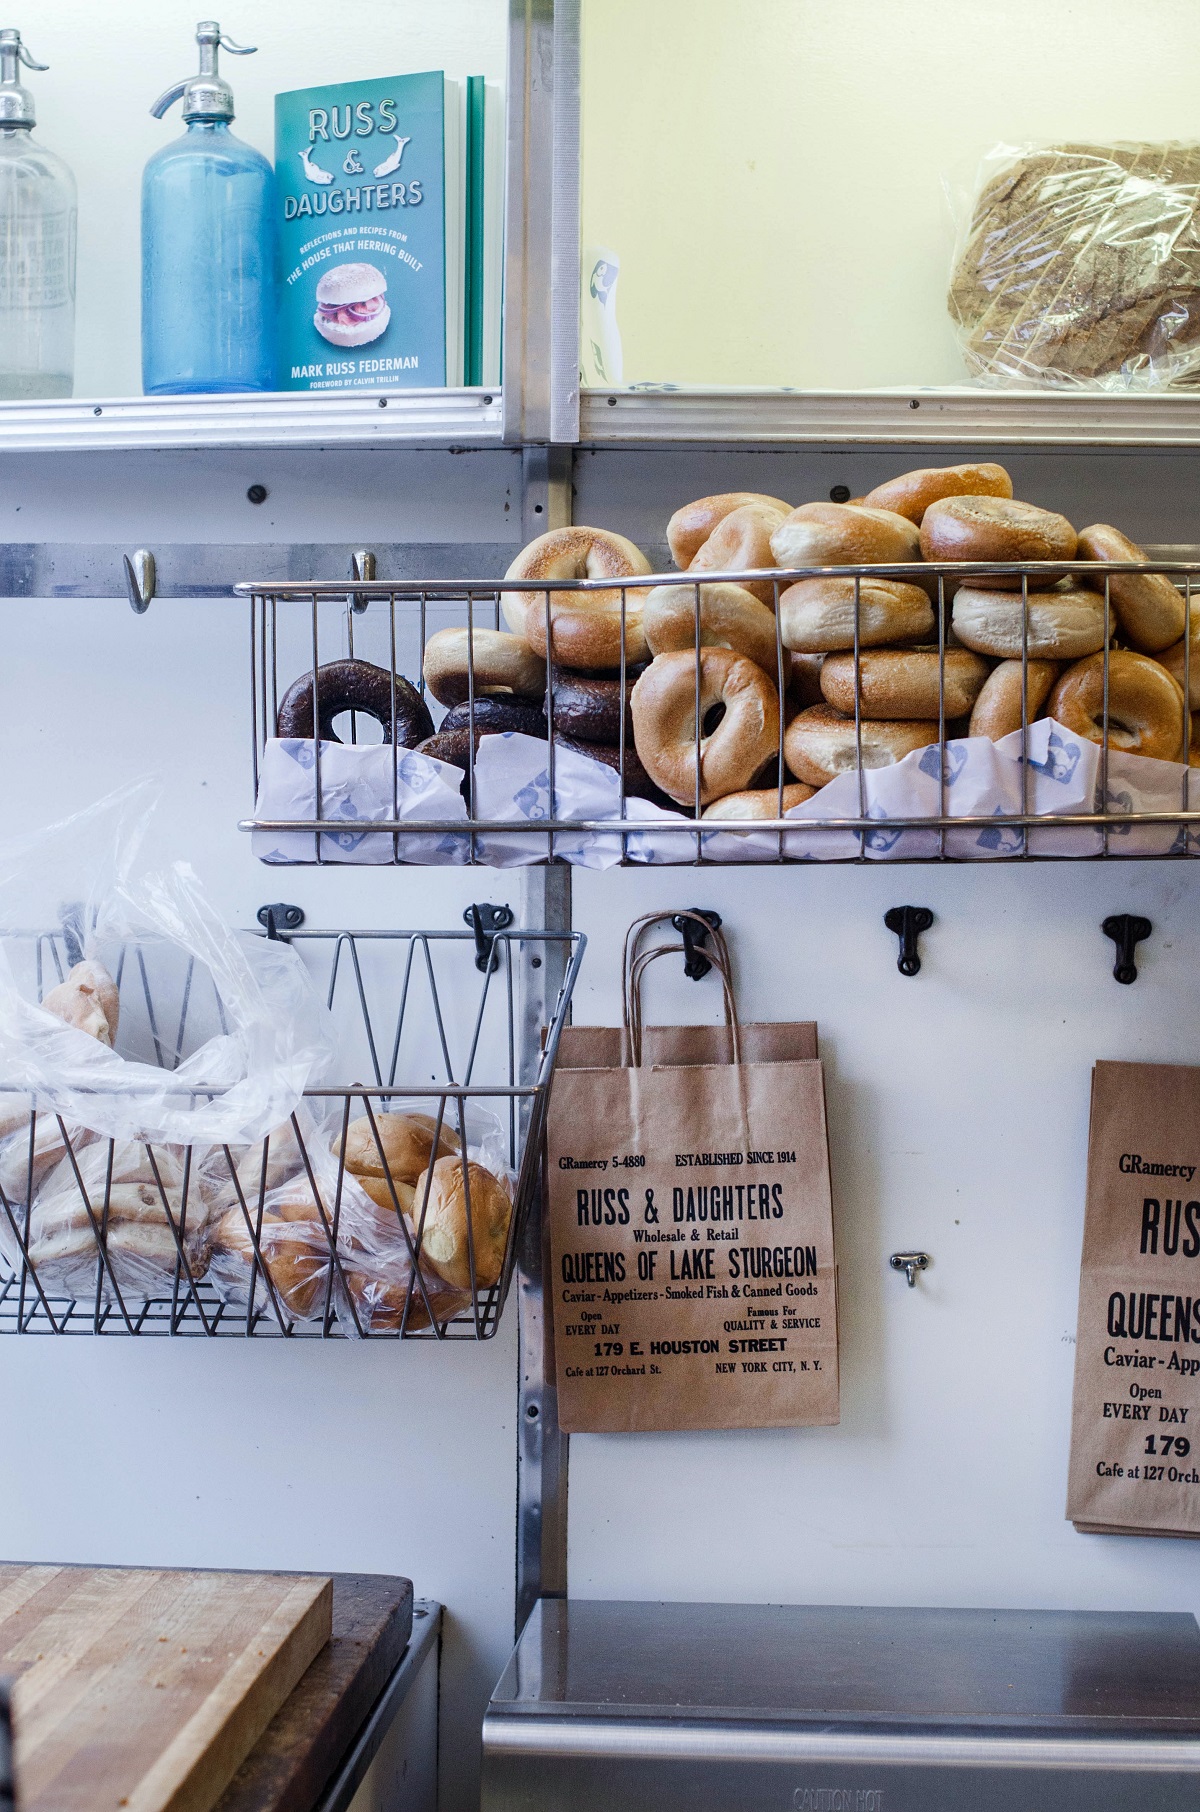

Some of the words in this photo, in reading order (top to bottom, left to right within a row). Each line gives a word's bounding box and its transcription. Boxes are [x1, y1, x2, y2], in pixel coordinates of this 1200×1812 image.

[309, 99, 398, 142] RUSS
[342, 149, 364, 174] &
[284, 180, 423, 219] DAUGHTERS
[299, 230, 342, 255] REFLECTIONS
[343, 227, 358, 236] AND
[360, 226, 387, 236] RECIPES
[388, 229, 408, 243] FROM
[286, 266, 303, 286] THE
[301, 247, 332, 271] HOUSE
[332, 240, 356, 254] THAT
[357, 240, 397, 256] HERRING
[397, 249, 423, 272] BUILT
[291, 364, 323, 379] MARK
[326, 362, 355, 376] RUSS
[359, 356, 419, 373] FEDERMAN
[310, 381, 342, 389] FOREWORD
[376, 375, 399, 384] TRILLIN
[558, 1156, 609, 1171] GRamercy
[612, 1155, 646, 1168] 5-4880
[675, 1152, 744, 1167] ESTABLISHED
[746, 1151, 775, 1164] SINCE
[777, 1151, 797, 1163] 1914
[1118, 1153, 1197, 1182] GRamercy
[576, 1188, 630, 1226] RUSS
[644, 1188, 660, 1224] &
[672, 1183, 784, 1223] DAUGHTERS
[633, 1229, 686, 1243] Wholesale
[690, 1228, 700, 1241] &
[706, 1228, 739, 1241] Retail
[561, 1252, 626, 1283] QUEENS
[638, 1251, 658, 1281] OF
[670, 1249, 716, 1280] LAKE
[728, 1246, 818, 1279] STURGEON
[706, 1285, 729, 1298] Fish
[731, 1284, 741, 1298] &
[742, 1283, 782, 1298] Canned
[785, 1282, 818, 1296] Goods
[581, 1311, 602, 1322] Open
[747, 1306, 779, 1317] Famous
[782, 1305, 797, 1316] For
[565, 1324, 596, 1336] EVERY
[601, 1323, 620, 1335] DAY
[723, 1319, 765, 1332] QUALITY
[770, 1319, 778, 1329] &
[782, 1317, 821, 1329] SERVICE
[594, 1342, 623, 1356] 179
[630, 1341, 644, 1356] E.
[650, 1339, 719, 1355] HOUSTON
[728, 1337, 787, 1353] STREET
[565, 1366, 583, 1377] Cafe
[585, 1366, 594, 1376] at
[595, 1365, 609, 1376] 127
[610, 1364, 646, 1376] Orchard
[650, 1364, 662, 1375] St.
[715, 1362, 736, 1374] NEW
[741, 1361, 768, 1373] YORK
[772, 1360, 796, 1373] CITY,
[1129, 1383, 1162, 1401] Open
[1102, 1402, 1151, 1420] EVERY
[1158, 1406, 1189, 1423] DAY
[1144, 1434, 1191, 1457] 179
[1096, 1461, 1124, 1477] Cafe
[1127, 1465, 1140, 1479] at
[1143, 1465, 1165, 1480] 127
[1167, 1467, 1200, 1484] Orch
[793, 1788, 852, 1811] CAUTION
[855, 1789, 884, 1811] HOT
